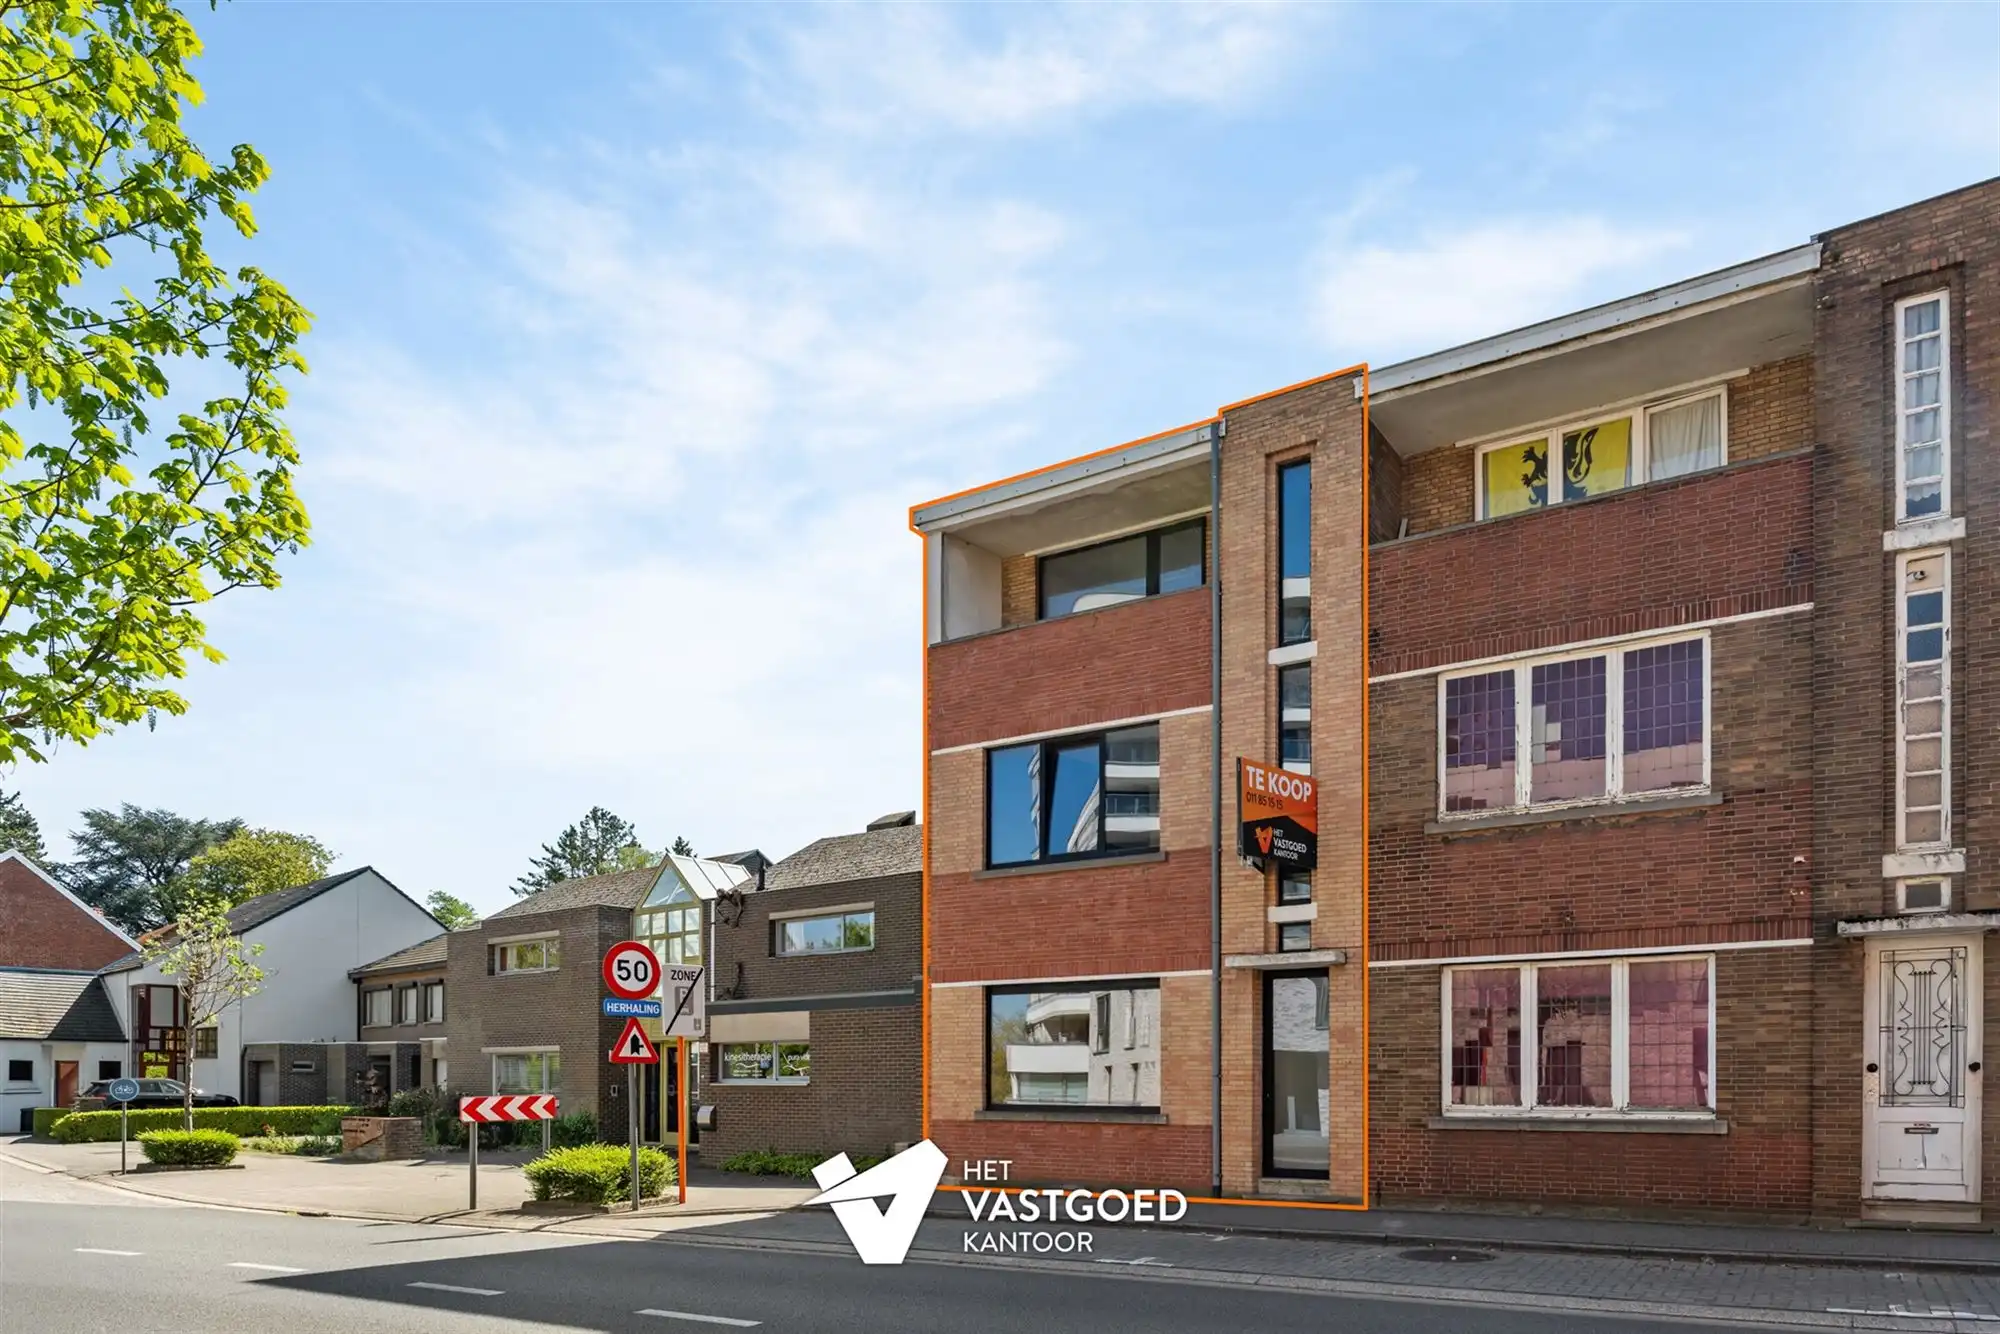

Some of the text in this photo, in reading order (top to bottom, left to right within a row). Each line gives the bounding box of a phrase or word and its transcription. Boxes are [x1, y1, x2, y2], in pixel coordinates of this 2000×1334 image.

[1246, 765, 1312, 802] TE KOOP
[1246, 791, 1257, 804] 011
[1258, 794, 1267, 806] 85
[1276, 799, 1284, 810] 15
[1273, 828, 1284, 837] HET
[1273, 837, 1307, 853] VASTGOED
[1273, 848, 1299, 860] KANTOOR
[617, 959, 648, 982] 50
[670, 969, 696, 981] ZONE
[606, 1002, 660, 1014] HERHALING
